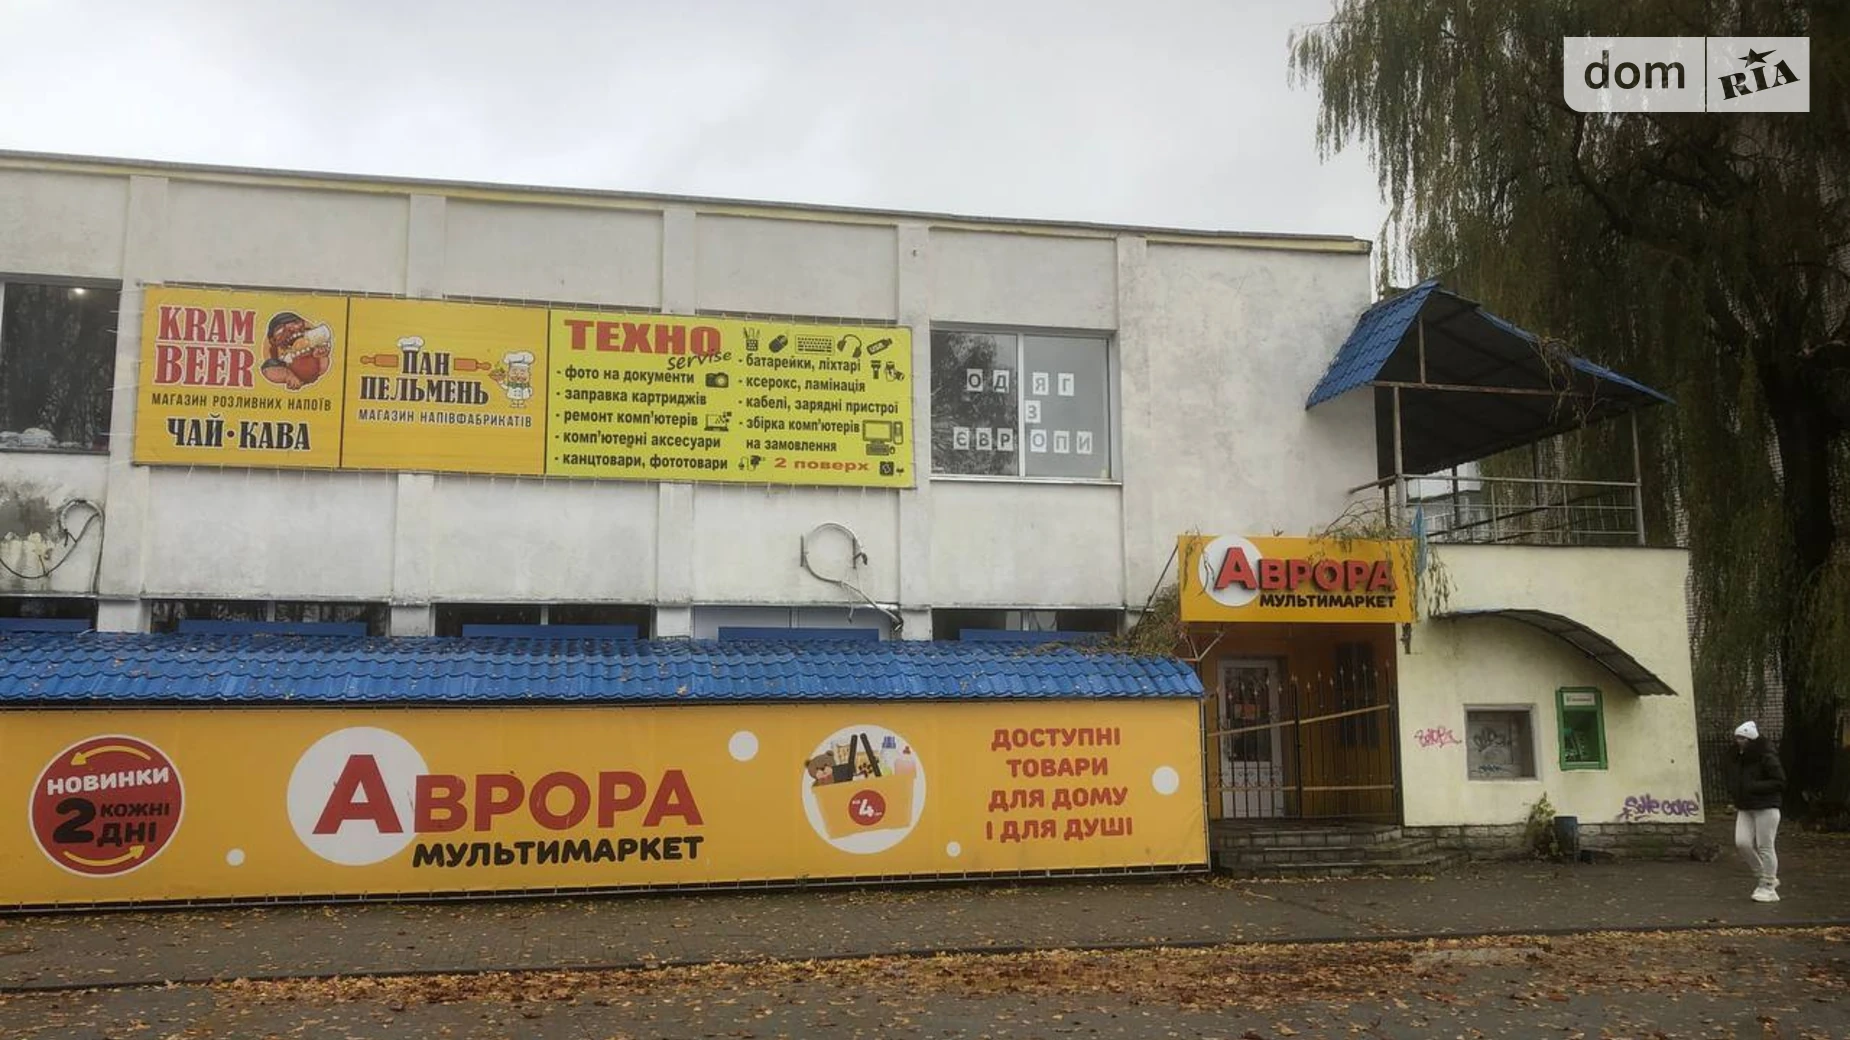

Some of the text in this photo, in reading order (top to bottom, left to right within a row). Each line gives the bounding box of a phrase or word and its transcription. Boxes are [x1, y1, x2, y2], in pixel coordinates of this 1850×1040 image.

[158, 306, 257, 344] KRAM
[564, 319, 722, 356] ТЕХНО
[154, 344, 255, 387] BEER
[402, 350, 450, 376] ПАН
[746, 353, 861, 374] батарейки, ліхтарі
[564, 364, 695, 385] фото на документи
[746, 376, 866, 393] ксерокс, ламінація
[359, 375, 490, 405] ПЕЛЬМЕНЬ
[564, 388, 707, 407] заправка картриджів
[151, 393, 332, 412] МАГАЗИН РОЗЛИВНИХ НАПОЇВ
[746, 395, 791, 411] кабелі,
[794, 399, 842, 414] зарядні
[358, 408, 532, 428] МАГАЗИН НАПІВФАБРИКАТІВ
[563, 410, 698, 428] ремонт комп'ютерів
[746, 416, 785, 432] збірка
[167, 413, 312, 450] ЧАЙ КАВА
[563, 430, 721, 451] комп'ютерні аксесуари
[746, 439, 838, 452] на замовлення
[562, 452, 728, 471] канцтовари, фототовари
[774, 457, 870, 473] 2 поверх
[1259, 594, 1396, 608] МУЛЬТИМАРКЕТ
[991, 727, 1121, 751] ДОСТУПНІ
[1006, 757, 1109, 778] ТОВАРИ
[47, 766, 169, 796] НОВИНКИ
[858, 798, 875, 818] 4
[988, 786, 1129, 813] ДЛЯ ДОМУ
[53, 797, 170, 844] 2 КОЖНІ
[986, 816, 1133, 843] І ДЛЯ ДУШІ
[96, 820, 157, 848] ДНІ
[412, 836, 704, 868] МУЛЬТИМАРКЕТ
